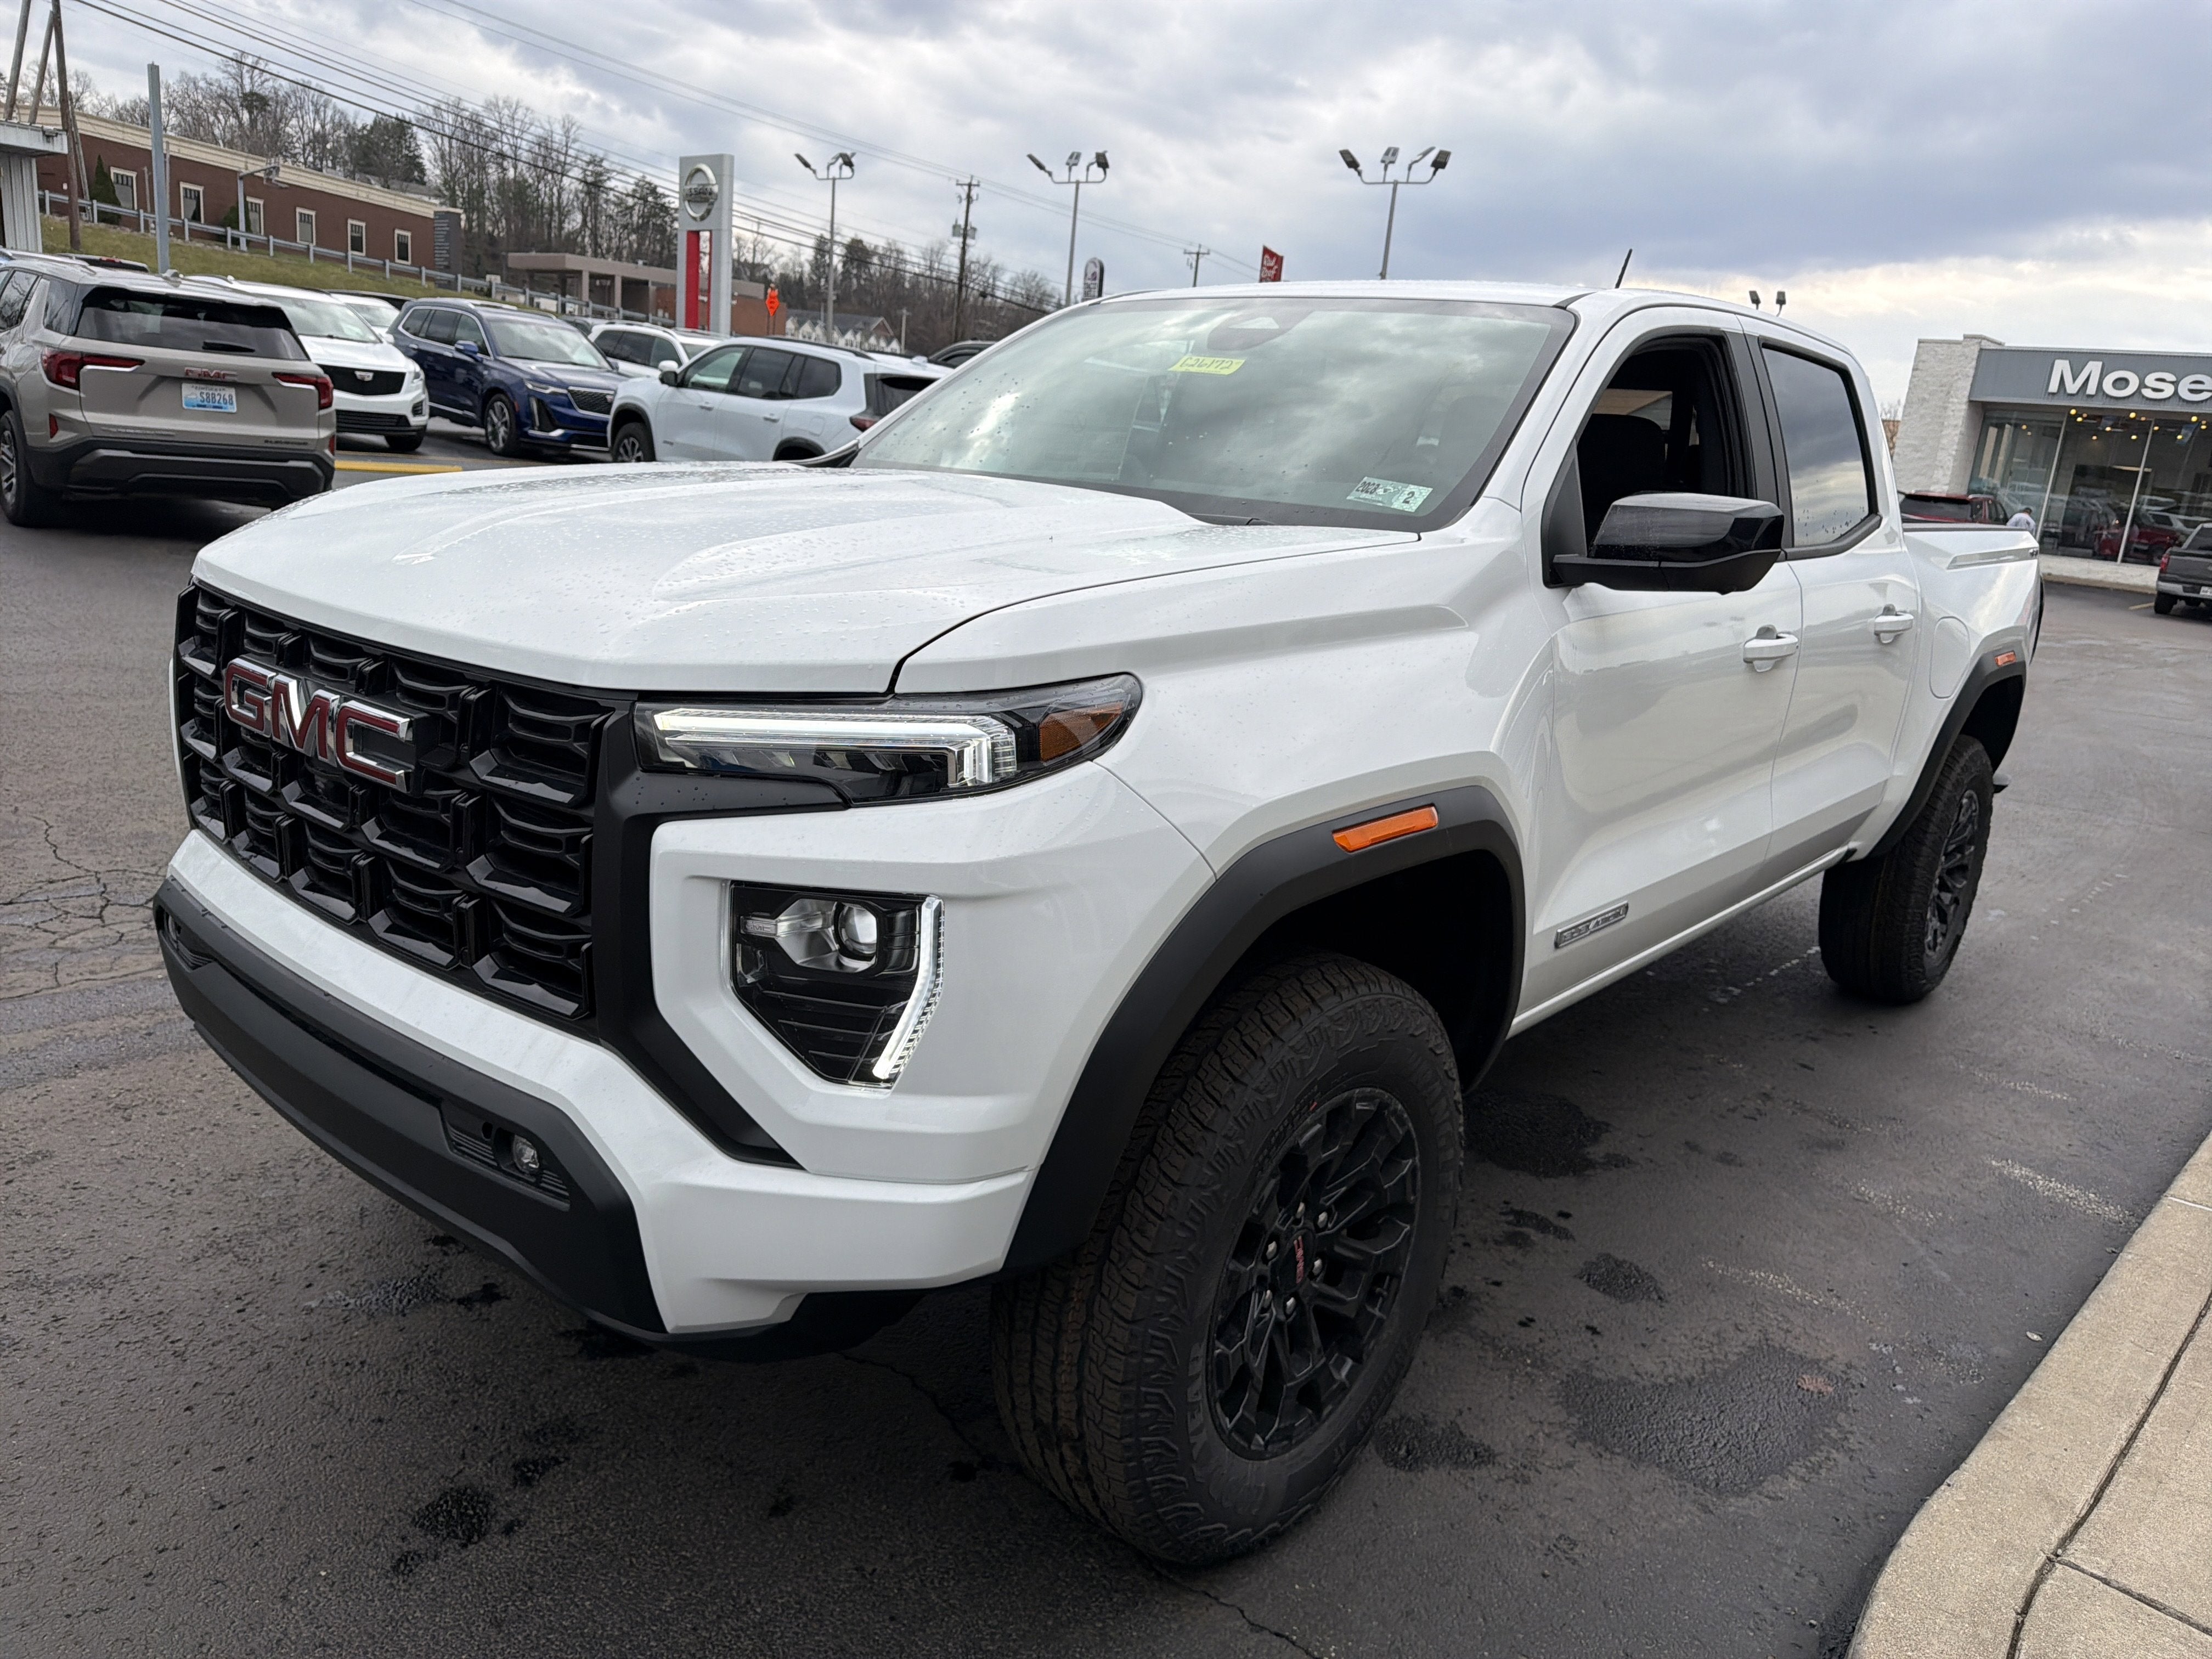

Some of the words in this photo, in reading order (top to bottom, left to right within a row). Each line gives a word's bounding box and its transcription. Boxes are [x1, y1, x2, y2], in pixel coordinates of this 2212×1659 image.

[184, 367, 238, 380] GMC
[2048, 358, 2212, 402] Mose
[1355, 481, 1381, 494] 2028
[1402, 491, 1415, 504] 2
[224, 657, 410, 792] GMC
[1293, 1235, 1305, 1284] GMC
